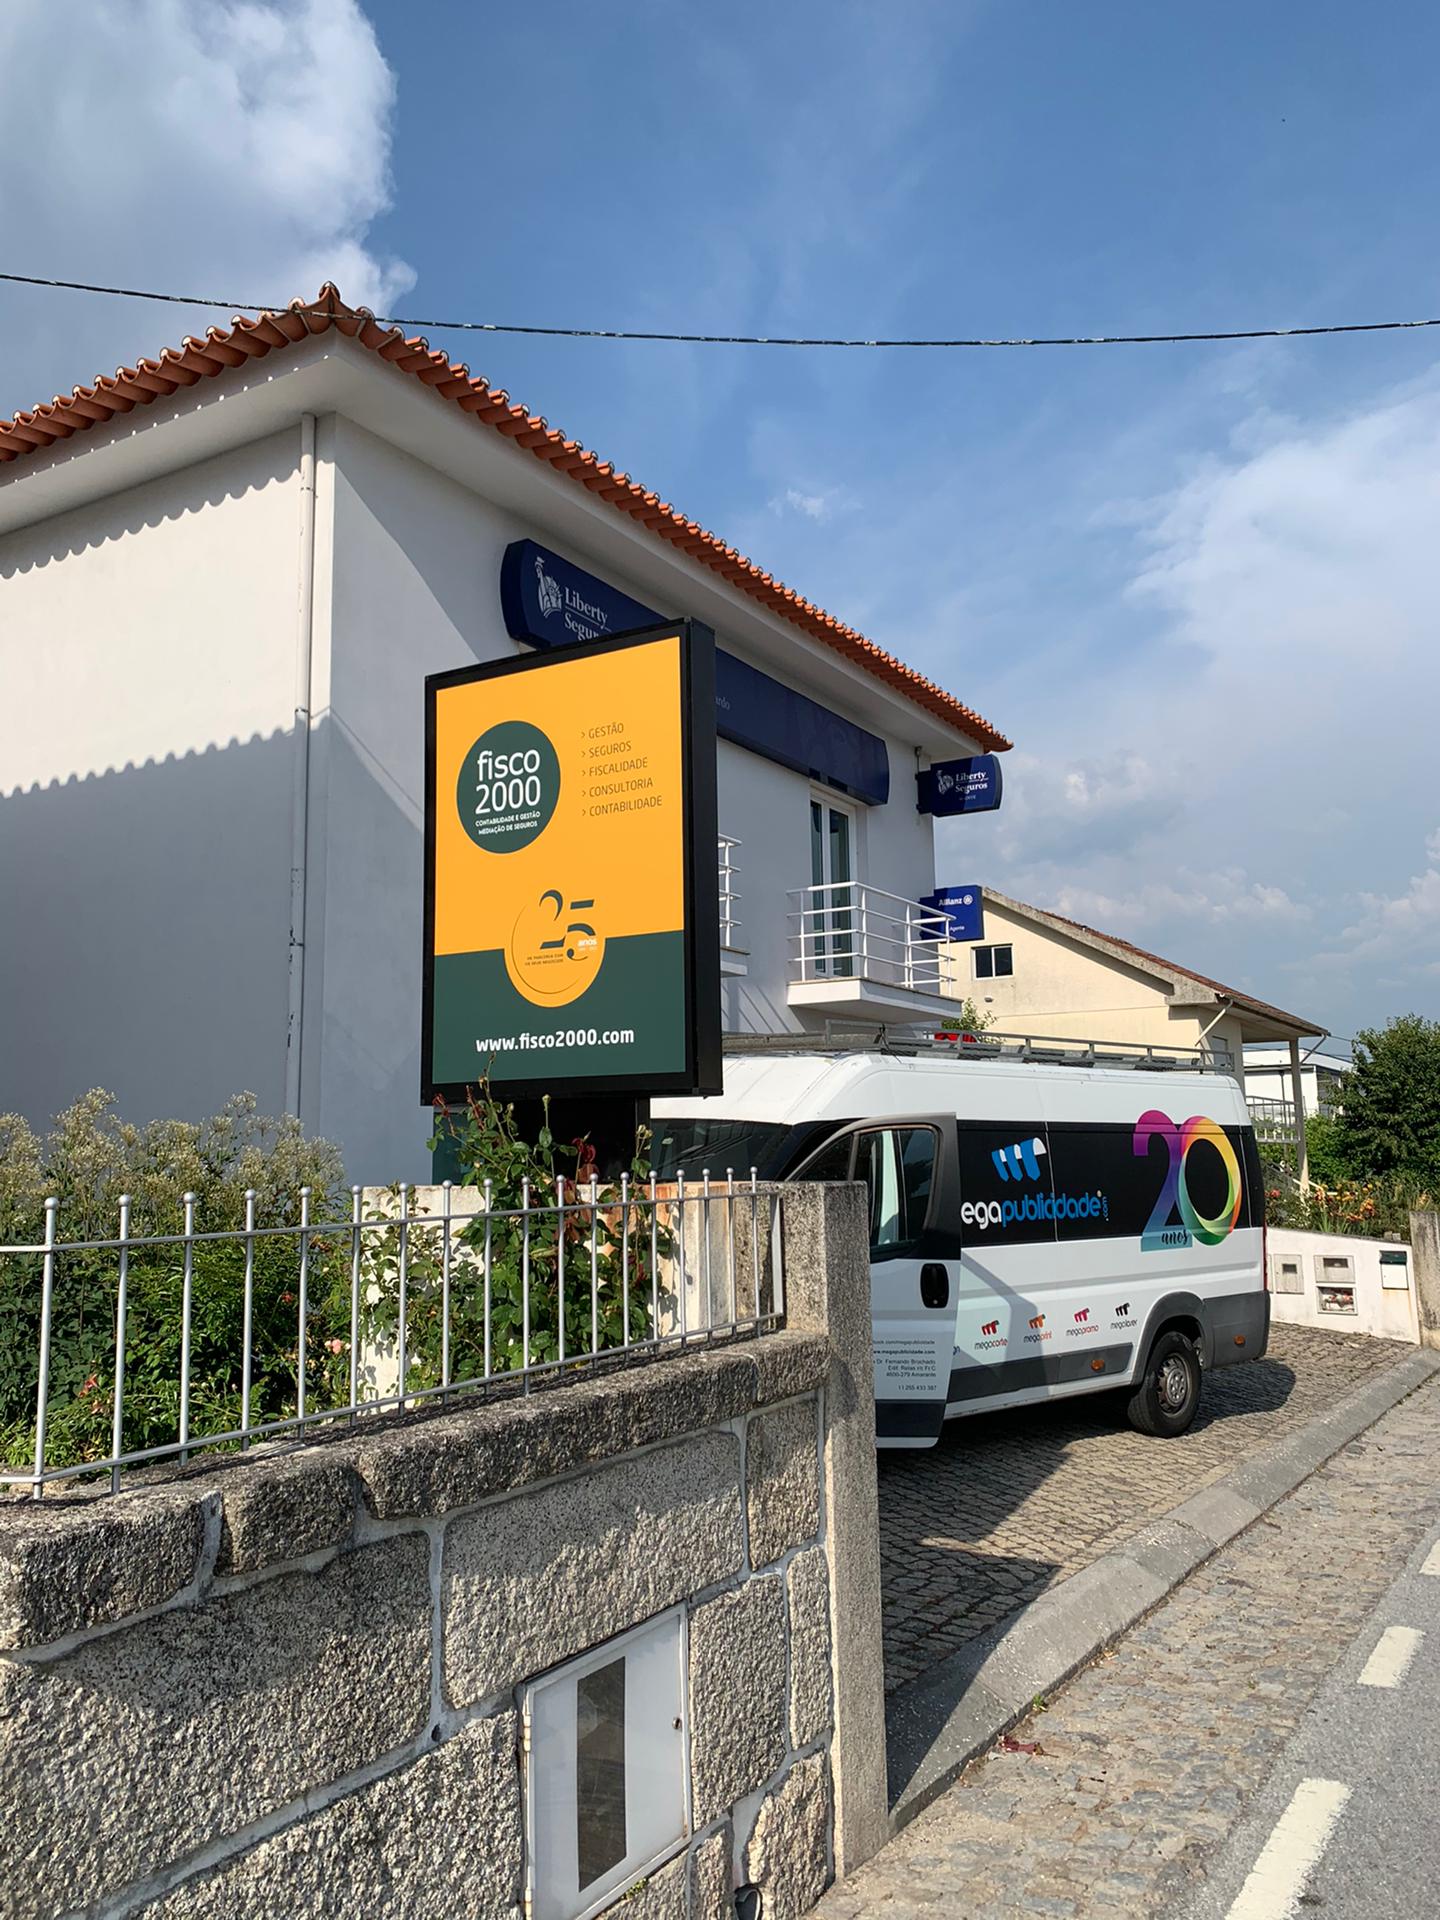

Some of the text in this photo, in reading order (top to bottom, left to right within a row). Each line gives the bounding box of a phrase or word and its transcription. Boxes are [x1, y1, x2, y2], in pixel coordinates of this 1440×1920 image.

[565, 587, 608, 629] Liberty
[565, 612, 599, 641] Segur
[588, 721, 625, 739] GESTÃO
[588, 741, 632, 758] SEGUROS
[477, 749, 540, 781] fisco
[589, 757, 648, 776] FISCALIDADE
[955, 771, 987, 782] Liberty
[475, 775, 541, 814] 2000
[589, 777, 653, 797] CONSULTORIA
[955, 782, 988, 794] Seguros
[589, 795, 662, 817] CONTABILIDADE
[475, 814, 515, 827] CONTABILIDADE
[519, 810, 541, 820] GESTÃO
[478, 825, 506, 835] MEDIAÇÃO
[514, 820, 538, 830] SEGUROS
[939, 897, 963, 906] Allianz
[476, 1028, 634, 1052] www.fisco2000.com
[1132, 1109, 1242, 1252] 20
[960, 1192, 1102, 1230] egapublicidade
[1161, 1229, 1189, 1245] anos
